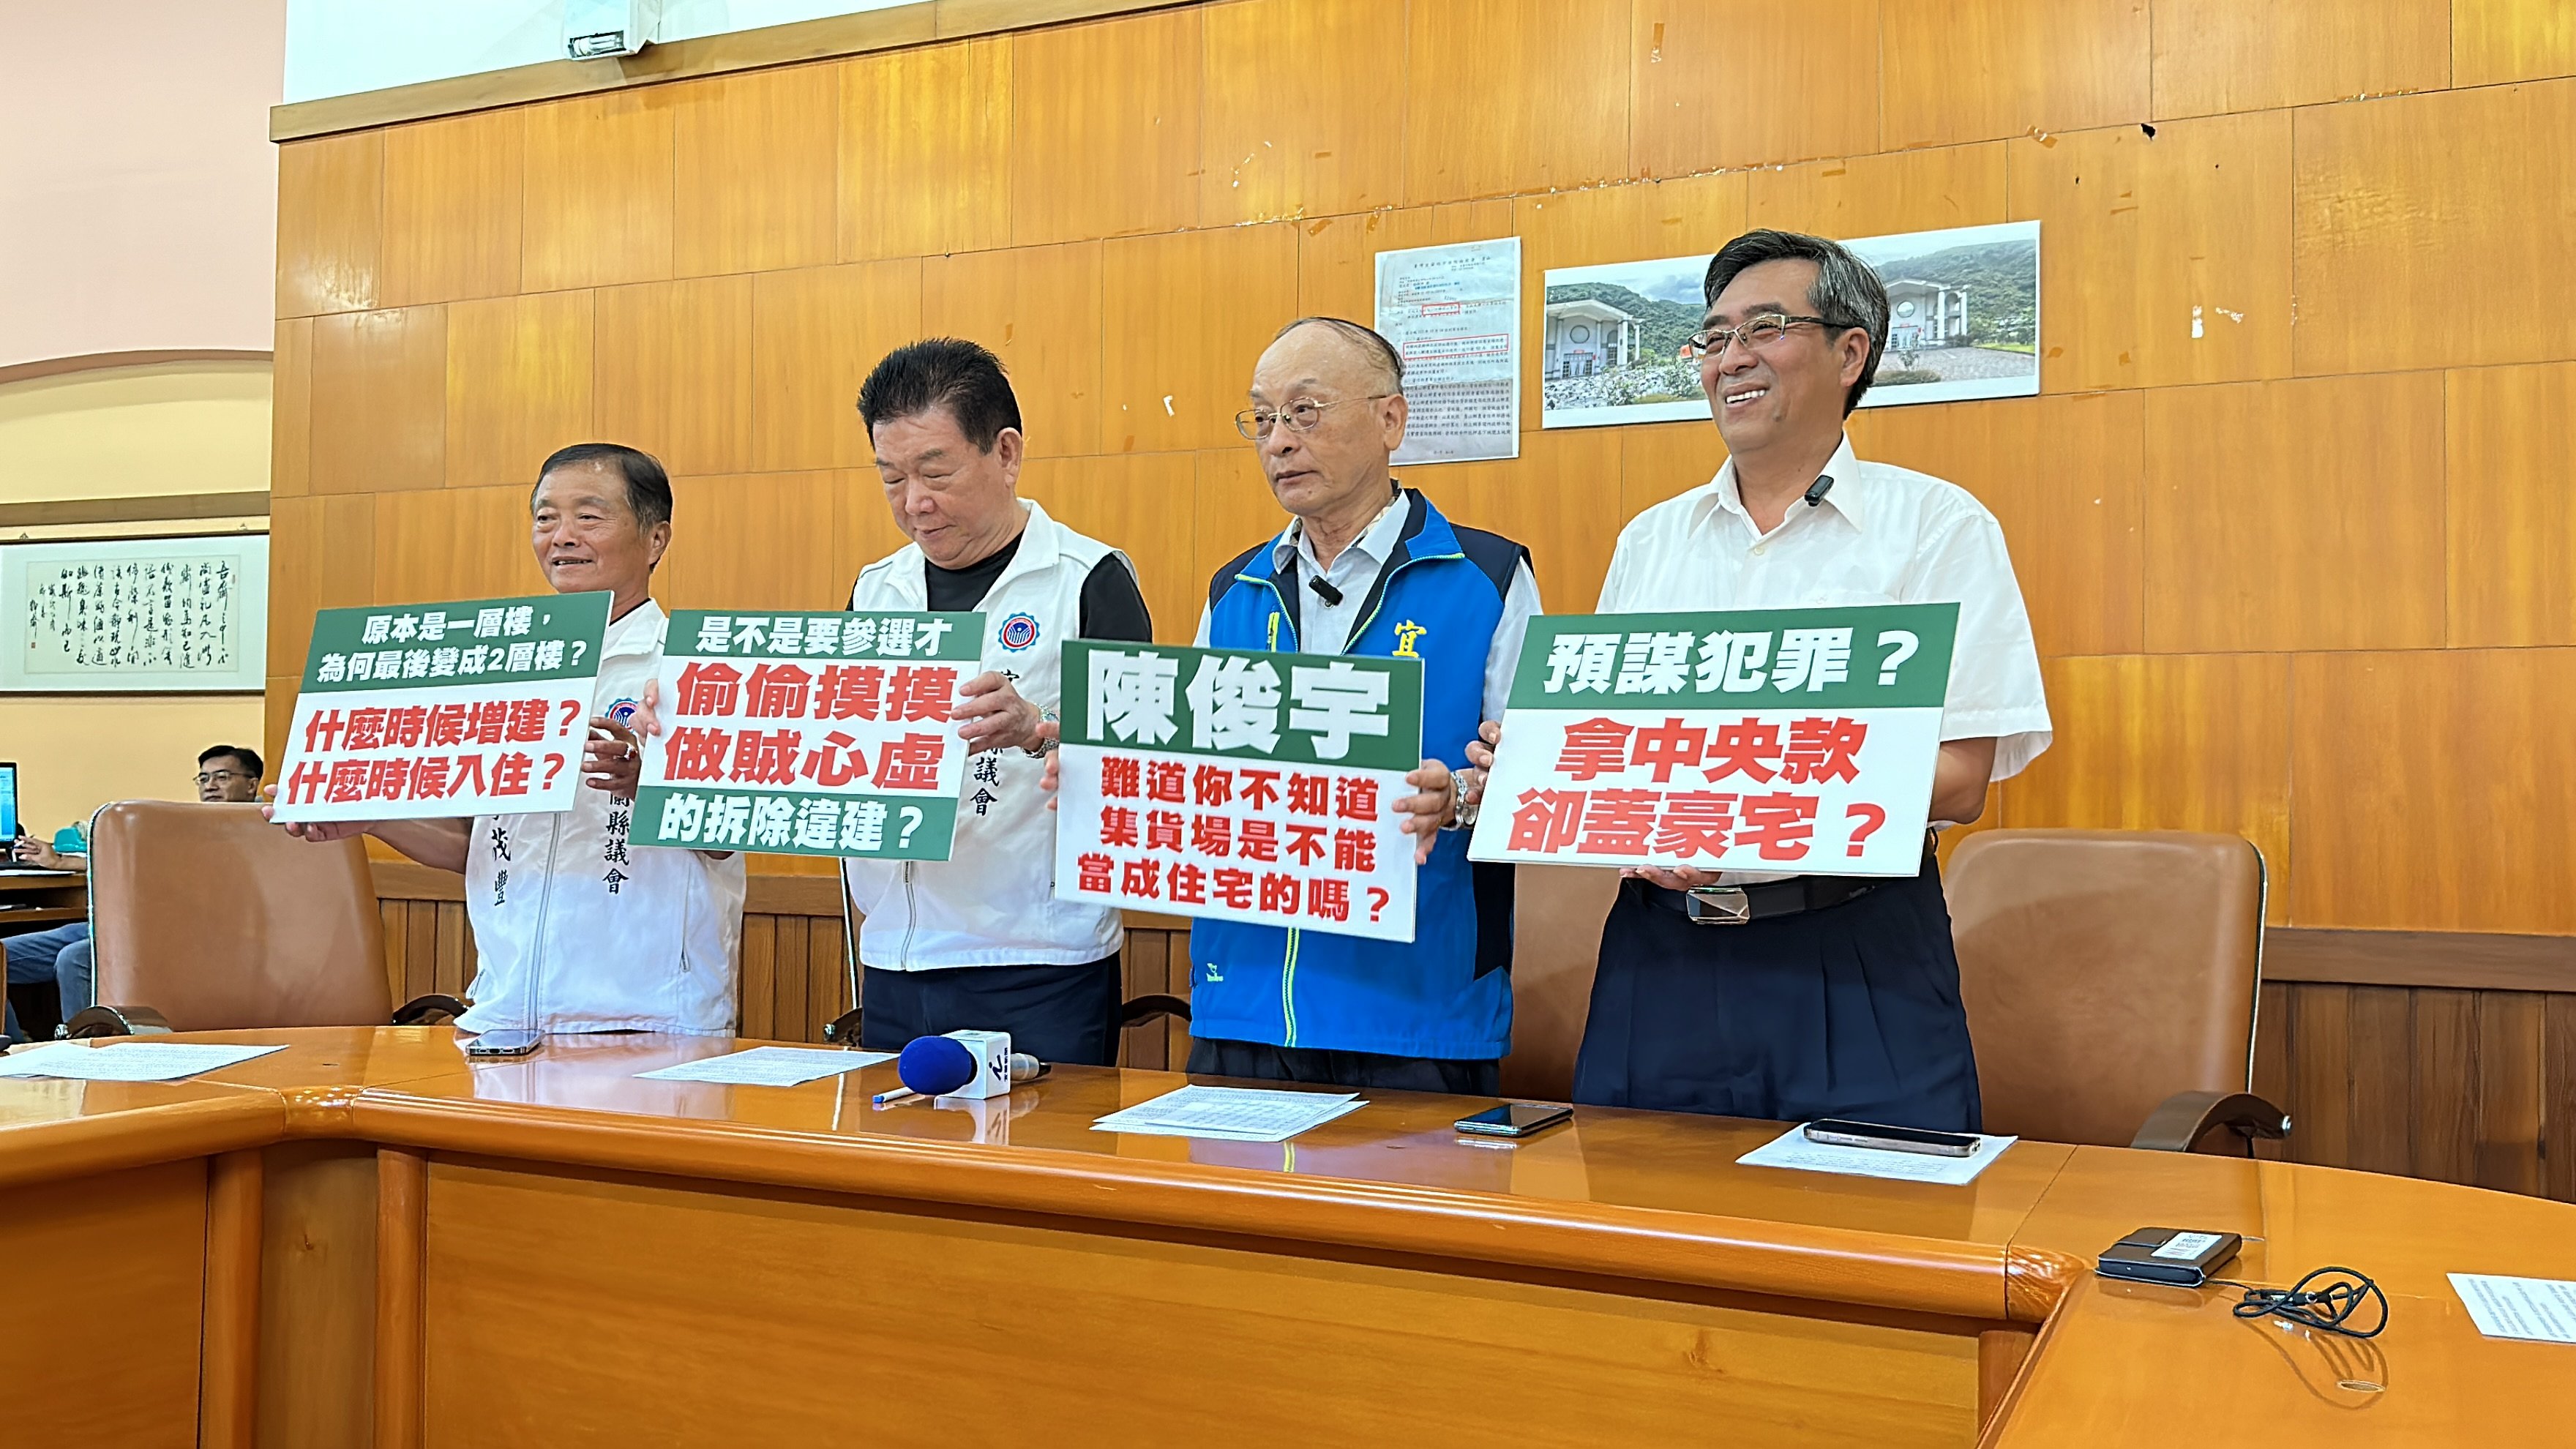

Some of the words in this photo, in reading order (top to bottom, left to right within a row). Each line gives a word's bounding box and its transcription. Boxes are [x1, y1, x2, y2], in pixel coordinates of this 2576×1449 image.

[361, 605, 552, 645] 原本是一層樓，
[697, 616, 953, 656] 是不是要參選才
[1392, 619, 1427, 659] 宜
[317, 640, 588, 684] 為何最後變成2層樓？
[676, 662, 957, 724] 偷偷摸摸
[1543, 626, 1920, 695] 預謀犯罪？
[305, 699, 580, 754] 什麼時候增建？
[1086, 648, 1390, 760] 陳俊宇
[288, 753, 566, 805] 什麼時候入住？
[663, 726, 946, 790] 做賊心虛
[970, 747, 1003, 817] 議會
[1554, 716, 1868, 785] 拿中央款
[658, 792, 925, 852] 的拆除違建？
[1101, 756, 1380, 823] 難道你不知道
[1100, 806, 1377, 873] 集貨場是不能
[1506, 787, 1887, 861] 卻蓋豪宅？
[491, 815, 512, 907] 茂豐
[1077, 852, 1390, 923] 當成住宅的嗎？
